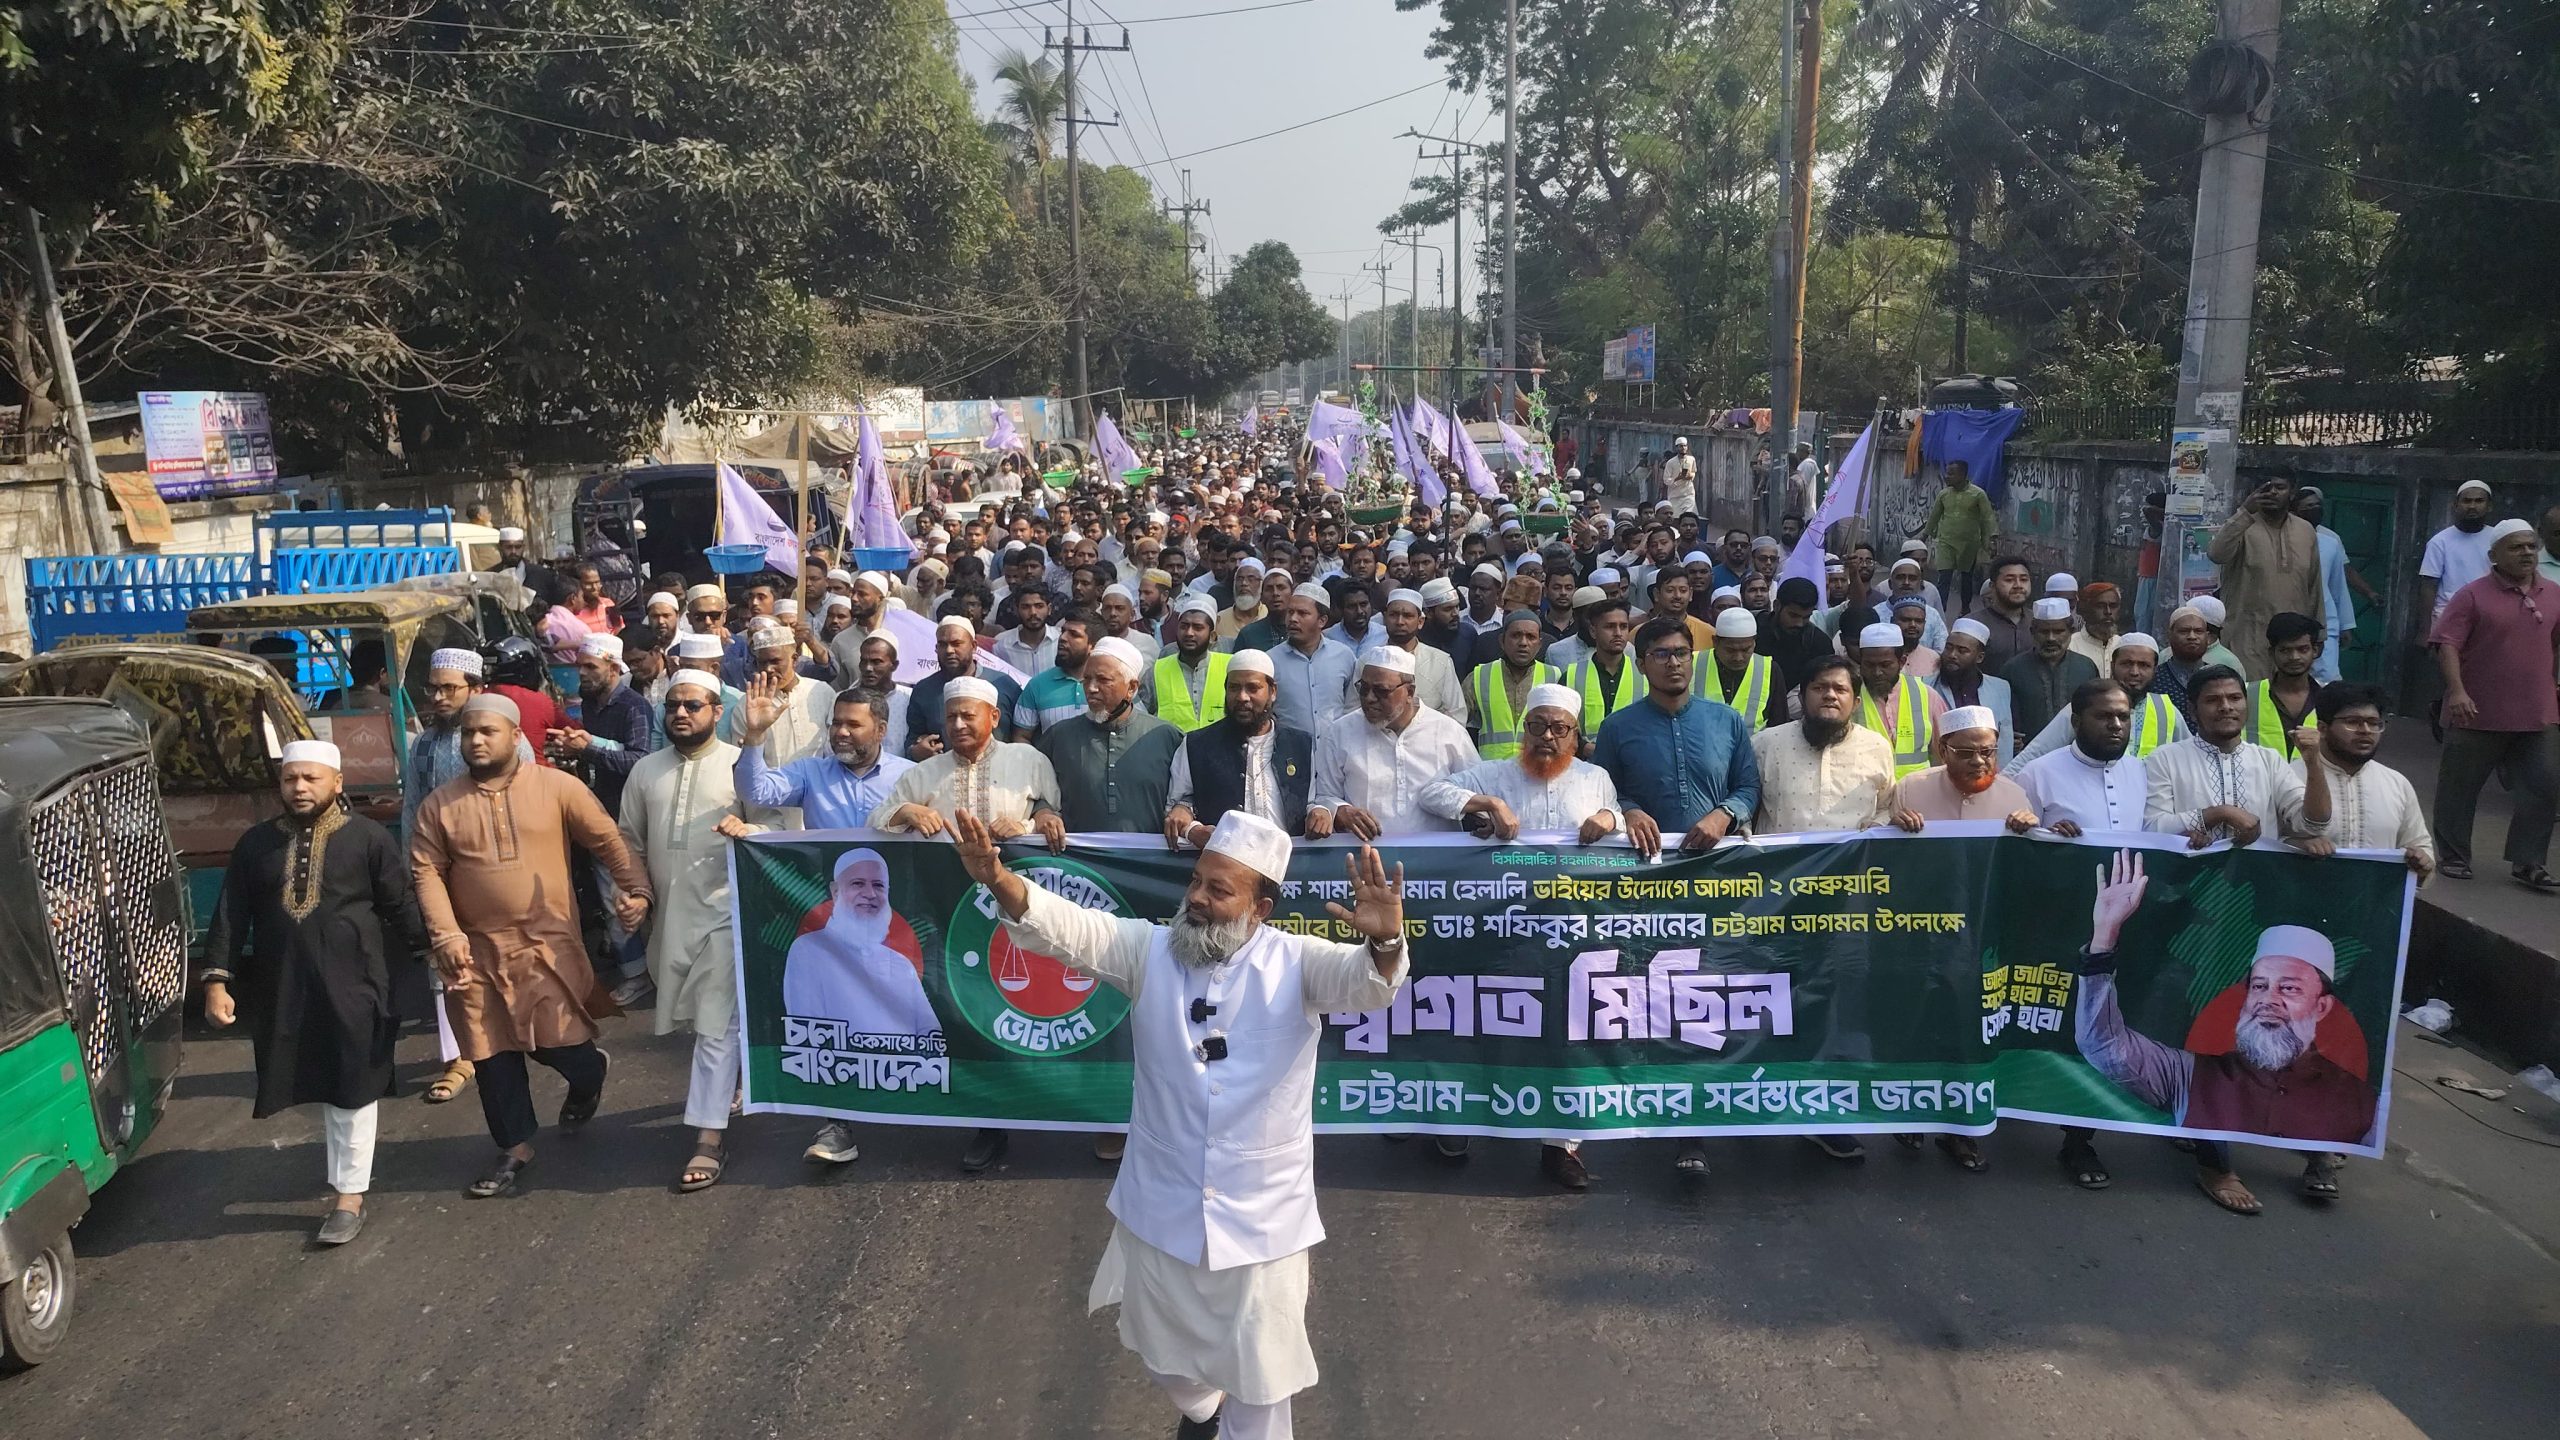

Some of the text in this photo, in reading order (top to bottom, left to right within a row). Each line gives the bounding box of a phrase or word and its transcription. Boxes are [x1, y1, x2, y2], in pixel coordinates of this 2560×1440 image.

[754, 532, 786, 548] বাংলাদেশ
[1492, 852, 1637, 867] বিসমিল্লাহির রহমানির রহিম
[1453, 873, 1527, 901] হেলালি
[1533, 874, 1611, 901] ভাইয়ের
[1617, 874, 1689, 900] উদ্যোগে
[1694, 871, 1764, 898] আগামী
[1770, 878, 1782, 896] ২
[1788, 867, 1891, 898] ফেব্রুয়ারি
[1483, 904, 1588, 950] শফিকুর
[1594, 912, 1707, 939] রহমানের
[1711, 911, 1786, 938] চট্টগ্রাম
[1791, 912, 1869, 934] আগমন
[1874, 907, 1967, 935] উপলক্ষে
[2013, 963, 2074, 990] জাতির
[1568, 948, 1795, 1052] মিছিল
[2009, 985, 2042, 1005] হবো
[2048, 988, 2069, 1008] না
[781, 1017, 948, 1055] চলো একসাথে গড়ি
[2017, 1006, 2064, 1034] হবো
[781, 1045, 951, 1094] বাংলাদেশ
[1553, 1083, 1694, 1119] আসনের
[1703, 1067, 1859, 1117] সর্বস্তরের
[1870, 1079, 1996, 1115] জনগণ
